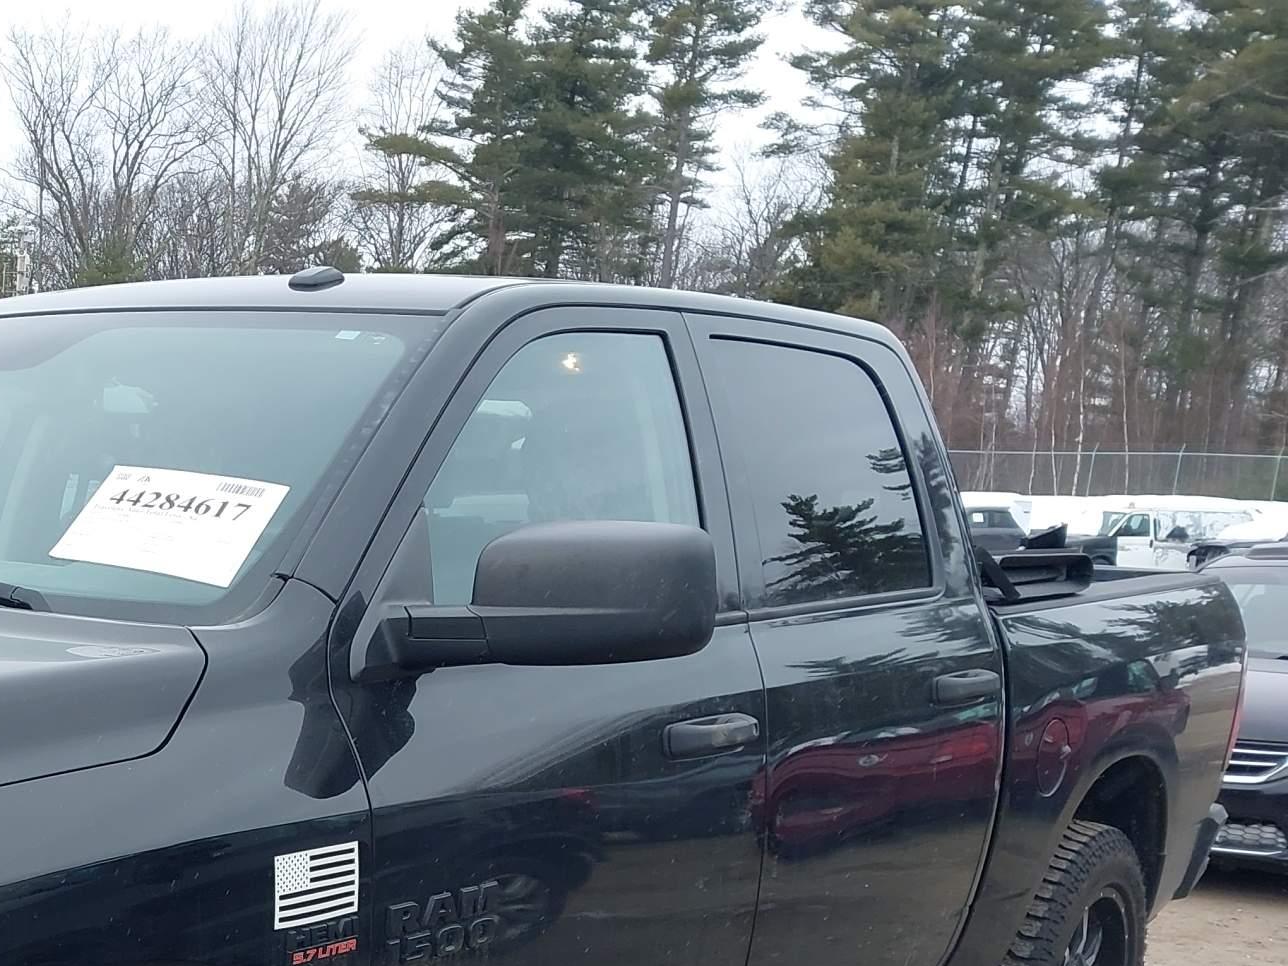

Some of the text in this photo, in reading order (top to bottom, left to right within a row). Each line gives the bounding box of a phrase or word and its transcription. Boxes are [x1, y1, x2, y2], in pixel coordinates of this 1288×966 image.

[110, 488, 252, 521] 44284617
[385, 880, 499, 937] RAM
[292, 938, 358, 966] 5.7 LITER
[386, 914, 500, 962] 1500
